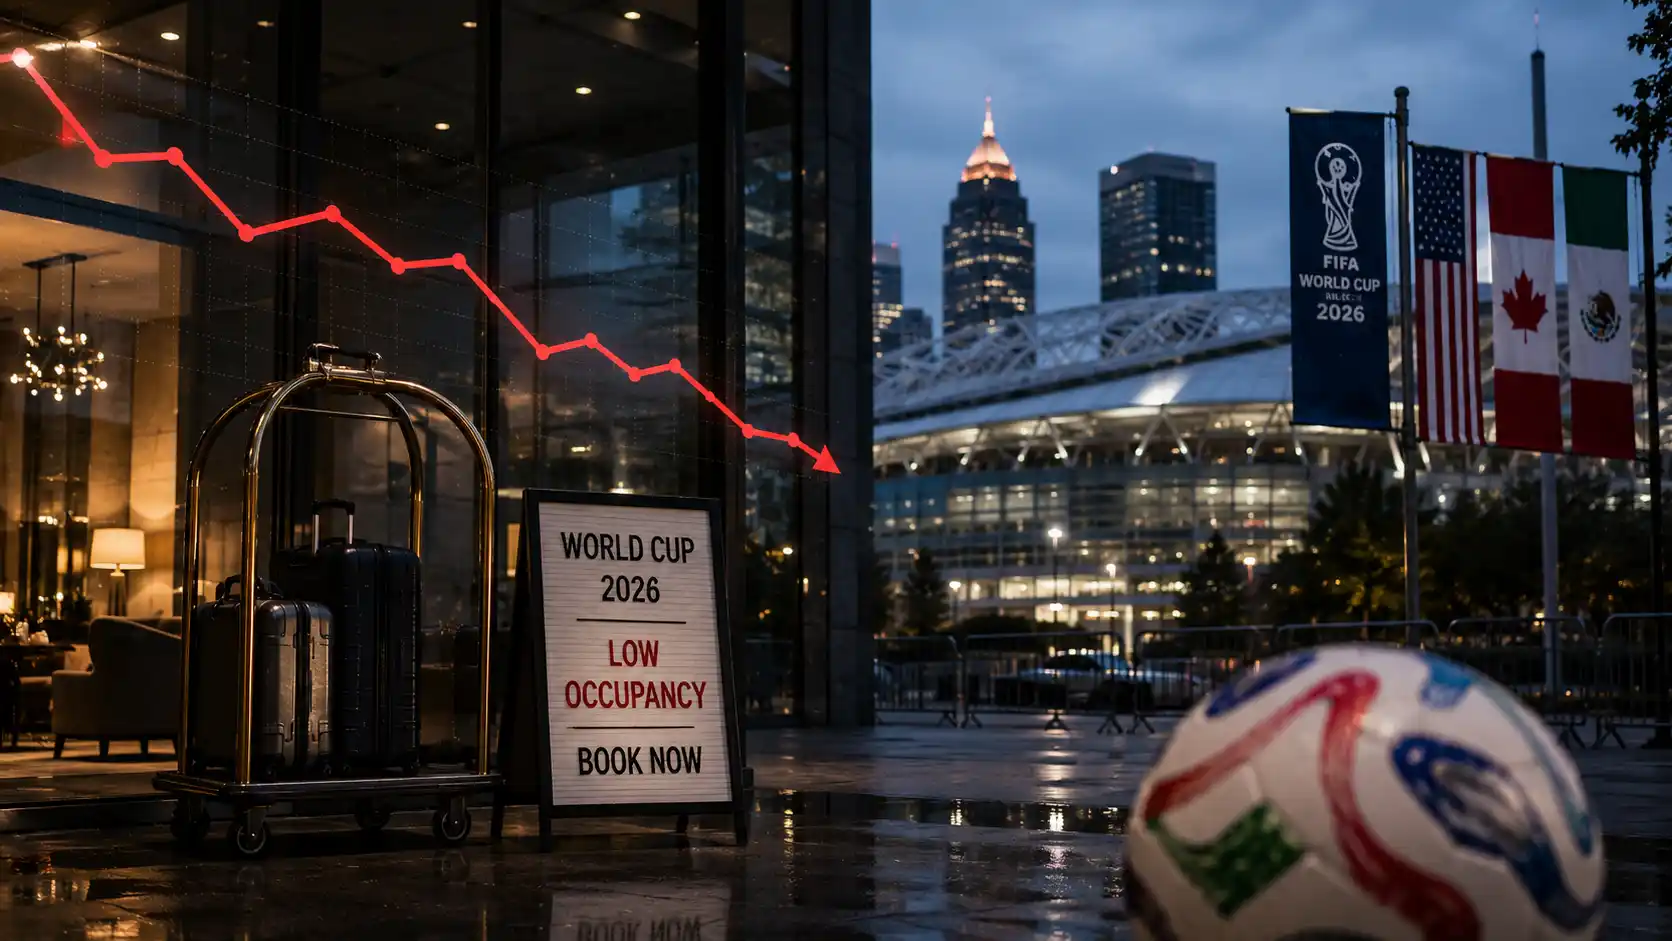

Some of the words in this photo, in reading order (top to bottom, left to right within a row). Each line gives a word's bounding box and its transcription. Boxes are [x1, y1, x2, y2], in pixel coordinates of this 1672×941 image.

[1323, 255, 1360, 271] FIFA
[1299, 274, 1350, 290] WORLD
[1353, 278, 1381, 292] CUP
[1316, 303, 1365, 323] 2026
[560, 532, 643, 562] WORLD
[651, 536, 695, 564] CUP
[601, 574, 660, 603] 2026
[608, 639, 659, 668] LOW
[565, 680, 707, 709] OCCUPANCY
[578, 746, 643, 776] BOOK
[650, 745, 702, 775] NOW
